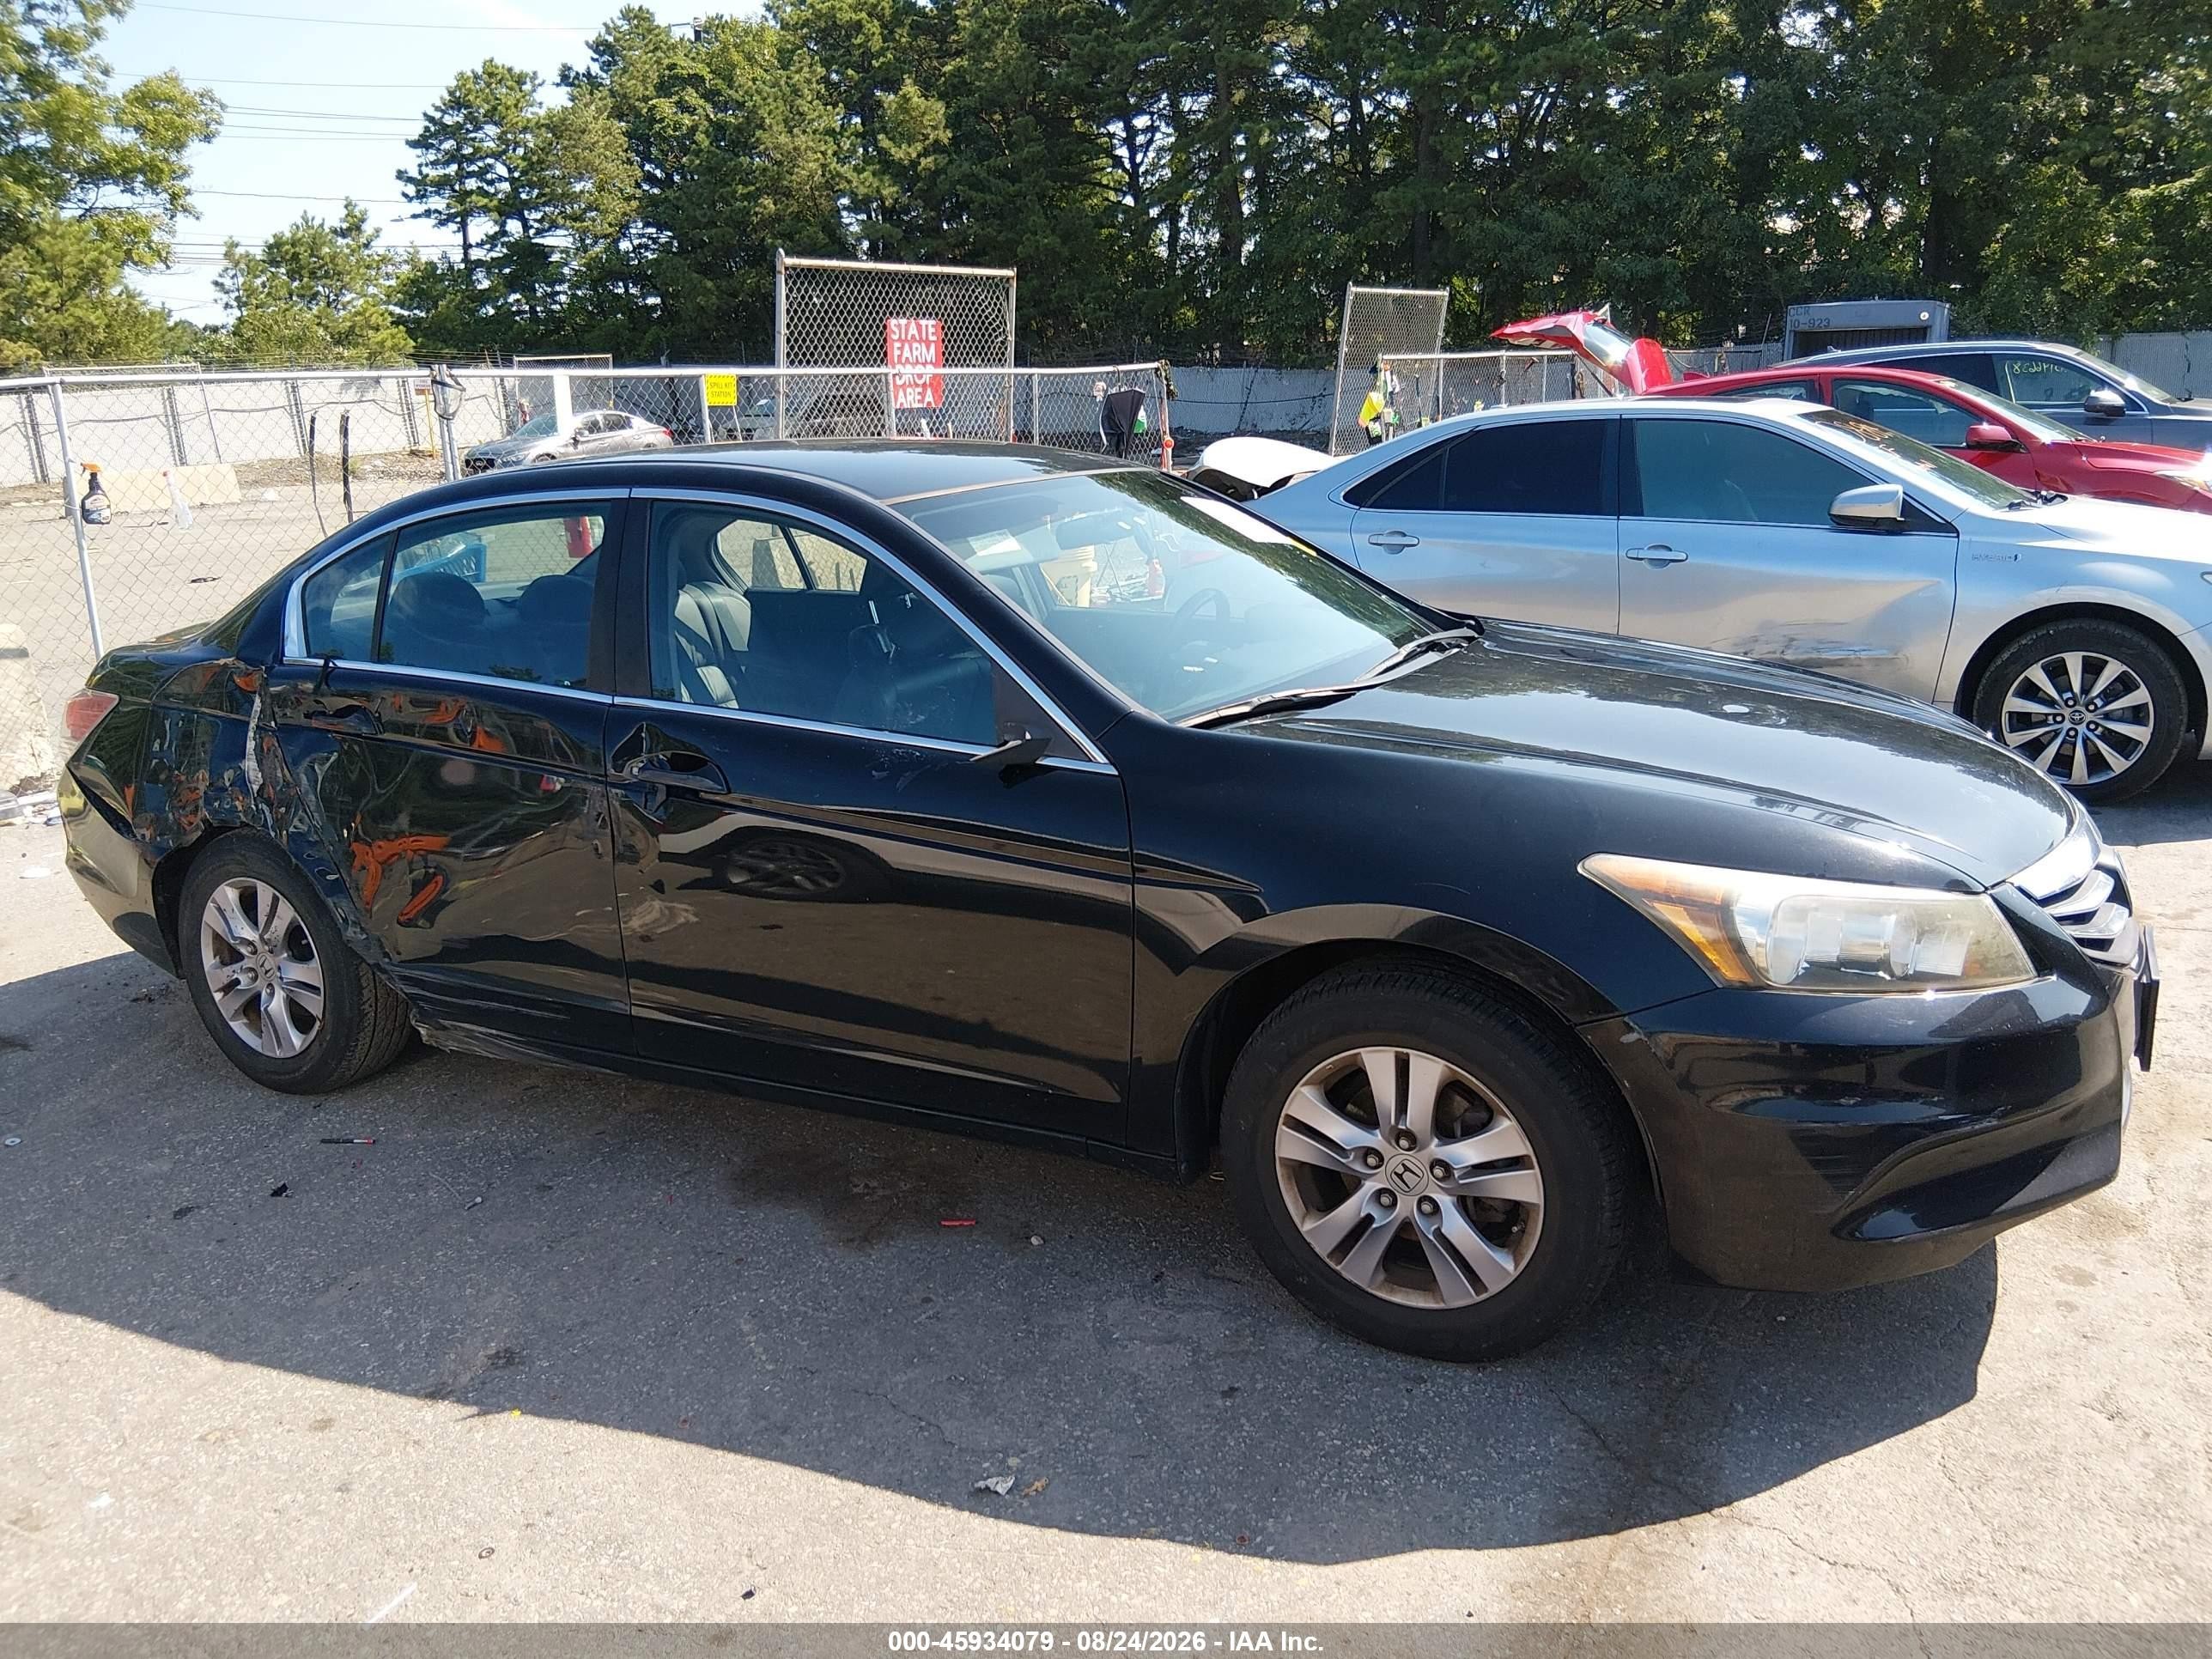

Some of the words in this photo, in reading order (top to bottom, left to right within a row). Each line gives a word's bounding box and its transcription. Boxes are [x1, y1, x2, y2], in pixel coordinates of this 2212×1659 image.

[890, 319, 938, 341] STATE
[1790, 318, 1831, 330] 10-923
[893, 343, 936, 363] FARM
[895, 364, 934, 385] DROP
[896, 387, 935, 408] AREA
